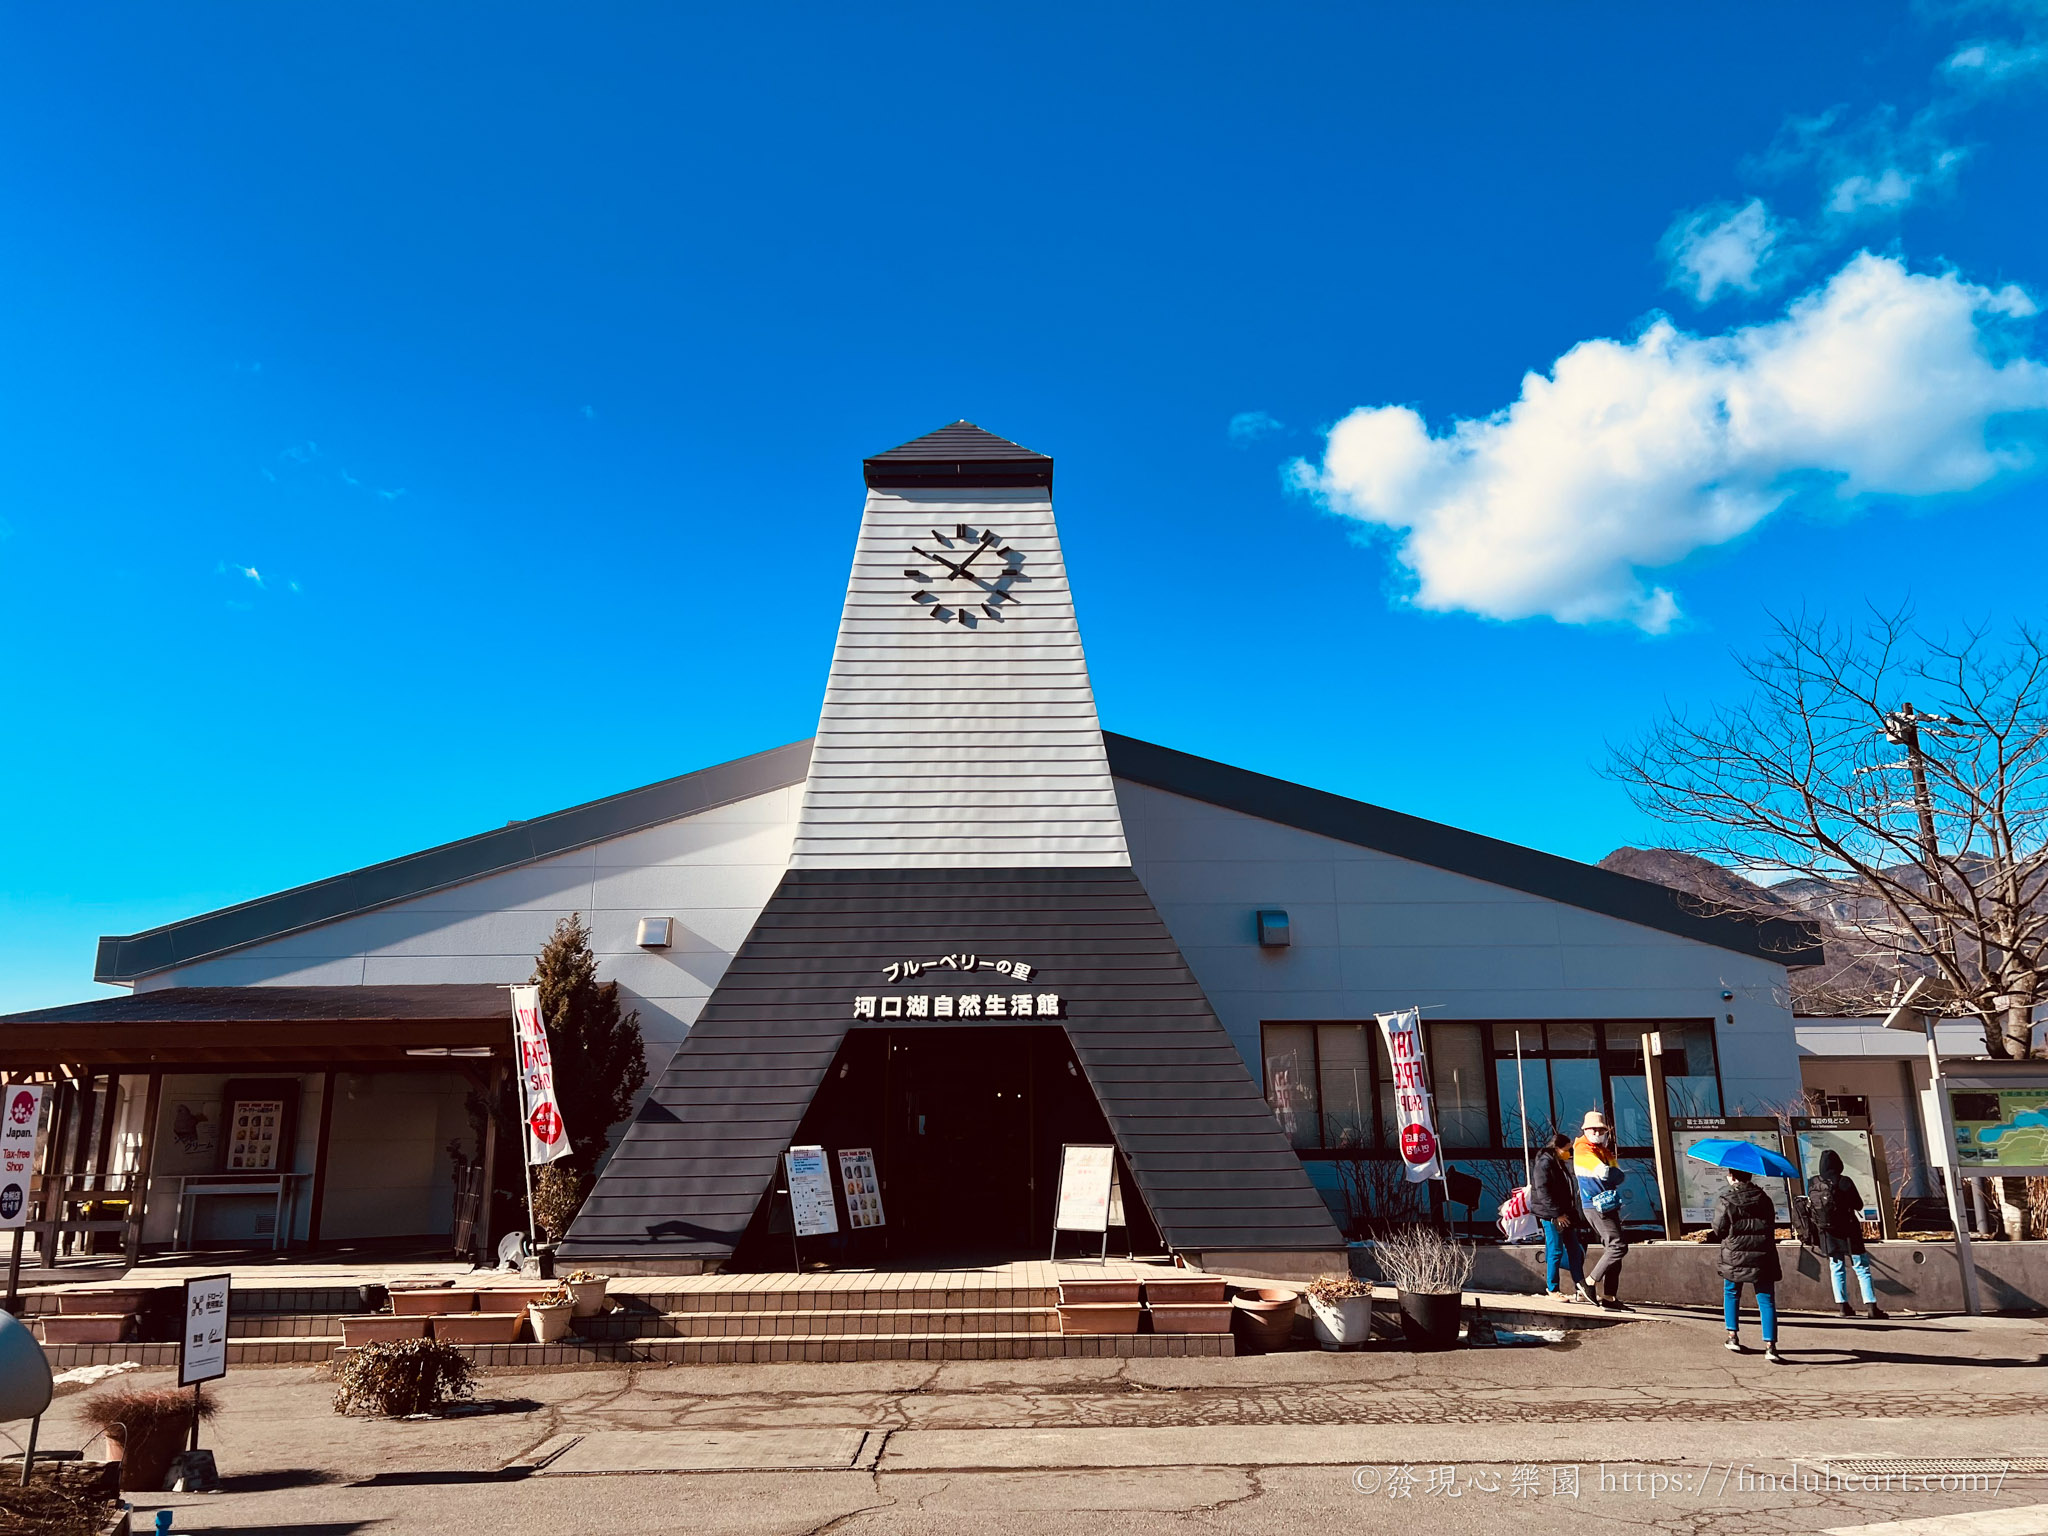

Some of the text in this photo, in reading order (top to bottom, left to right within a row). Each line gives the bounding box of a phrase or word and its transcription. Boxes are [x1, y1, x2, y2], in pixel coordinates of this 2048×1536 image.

[882, 953, 1032, 982] ブルーベリーの里
[853, 993, 1059, 1018] 河口湖自然生活館
[530, 1073, 551, 1091] SHO
[6, 1127, 33, 1140] Japan.
[3, 1148, 31, 1159] Tax-free
[5, 1161, 24, 1173] Shop
